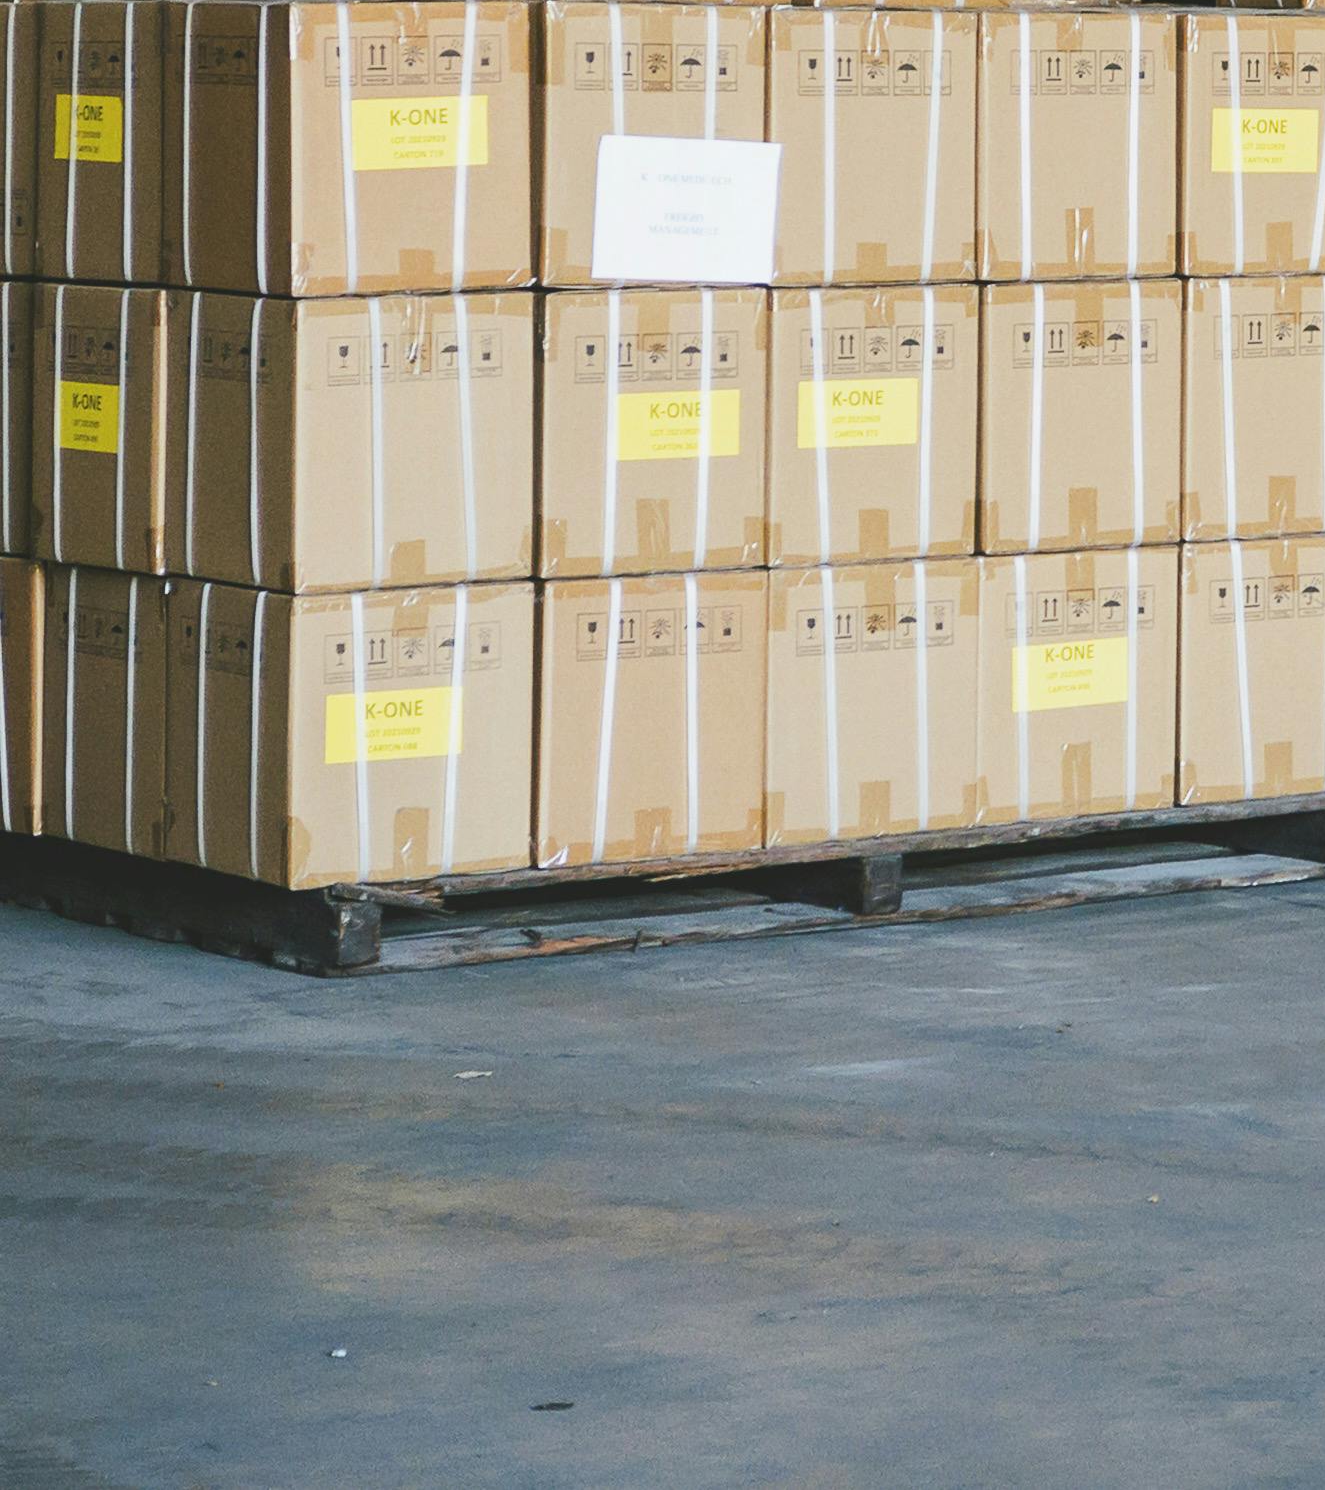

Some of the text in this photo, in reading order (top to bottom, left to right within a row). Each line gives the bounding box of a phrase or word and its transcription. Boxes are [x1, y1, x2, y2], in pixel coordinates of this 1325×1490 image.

[389, 108, 448, 126] K-ONE
[1242, 118, 1288, 135] K-ONE
[72, 393, 102, 411] K-ONE
[832, 390, 885, 407] K-ONE
[649, 401, 702, 419] K-ONE
[1045, 644, 1095, 663] K-ONE
[365, 700, 424, 719] K-ONE
